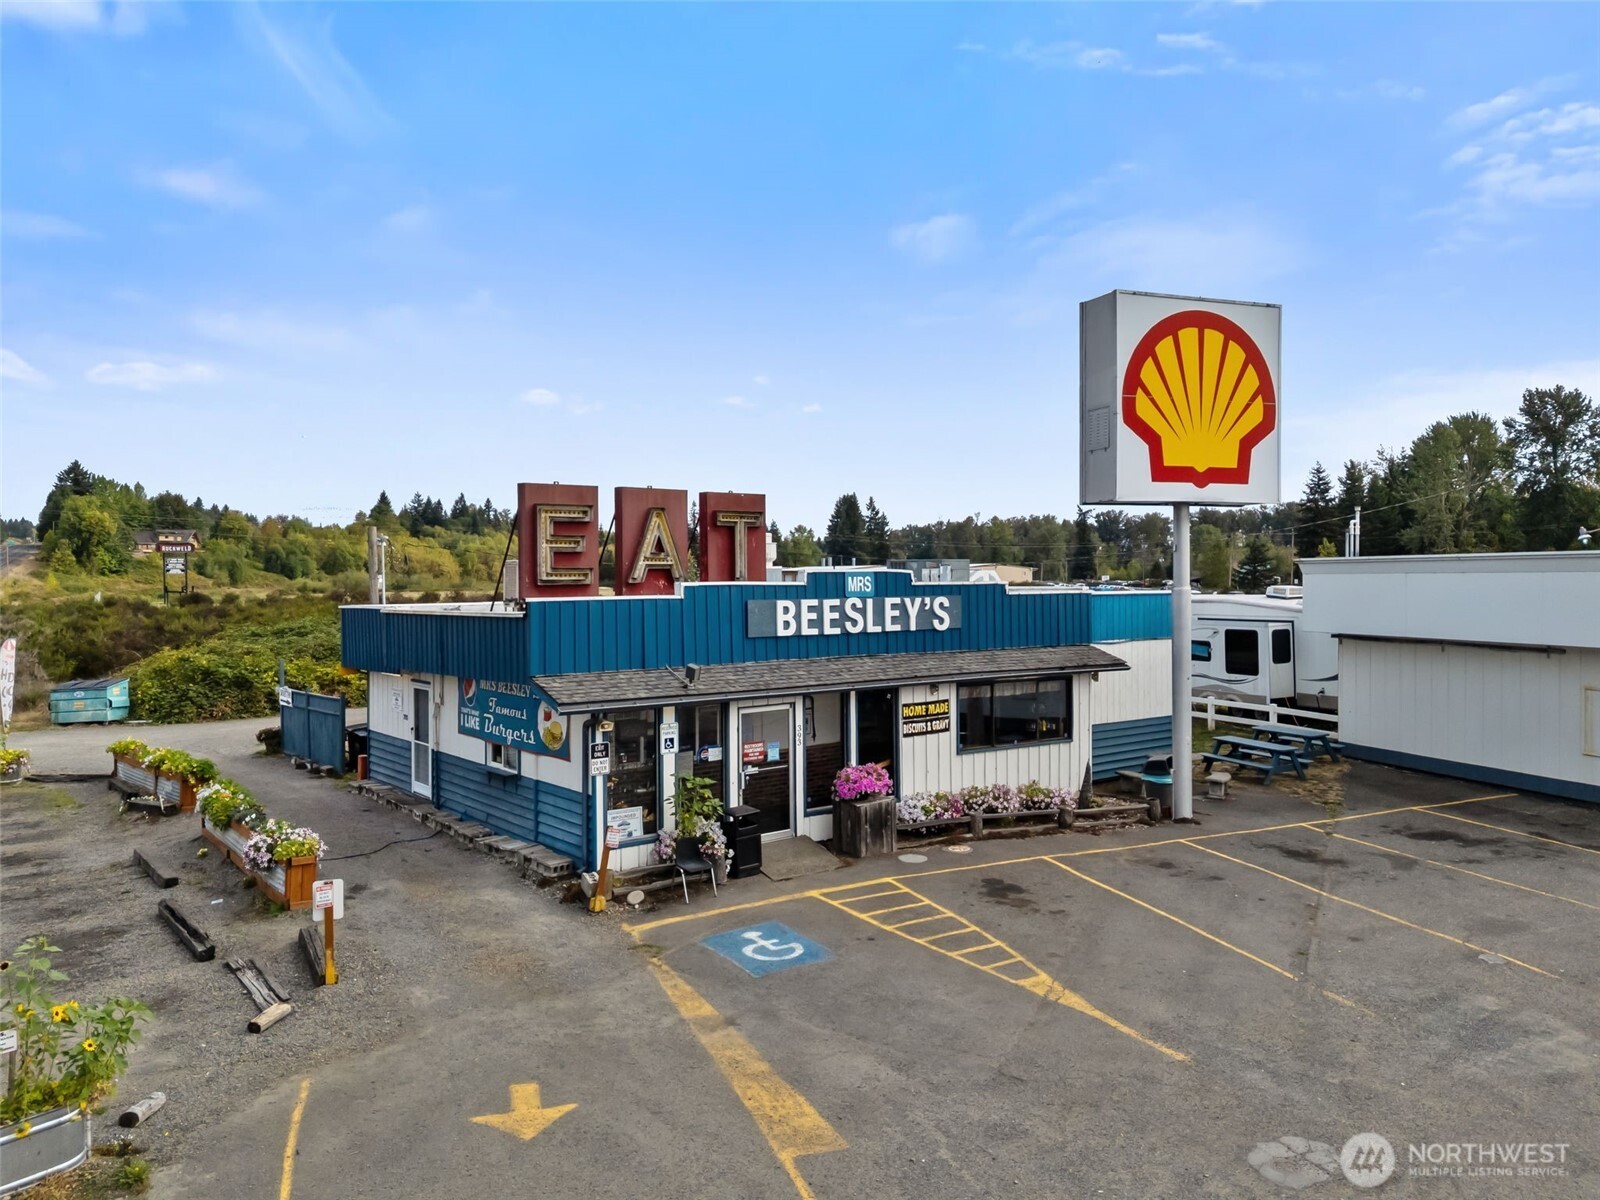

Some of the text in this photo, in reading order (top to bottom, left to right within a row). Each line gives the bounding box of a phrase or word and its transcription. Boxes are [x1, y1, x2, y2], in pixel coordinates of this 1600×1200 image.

[536, 504, 763, 586] EAT
[848, 576, 872, 592] MRS
[776, 596, 951, 637] BEESLEY'S
[497, 682, 539, 699] BEESLEY
[488, 697, 527, 720] Famous
[902, 702, 949, 717] HOME MADE
[464, 714, 480, 731] LIKE
[483, 713, 536, 745] Burgers
[903, 719, 949, 734] BISCUITS & GRAVY
